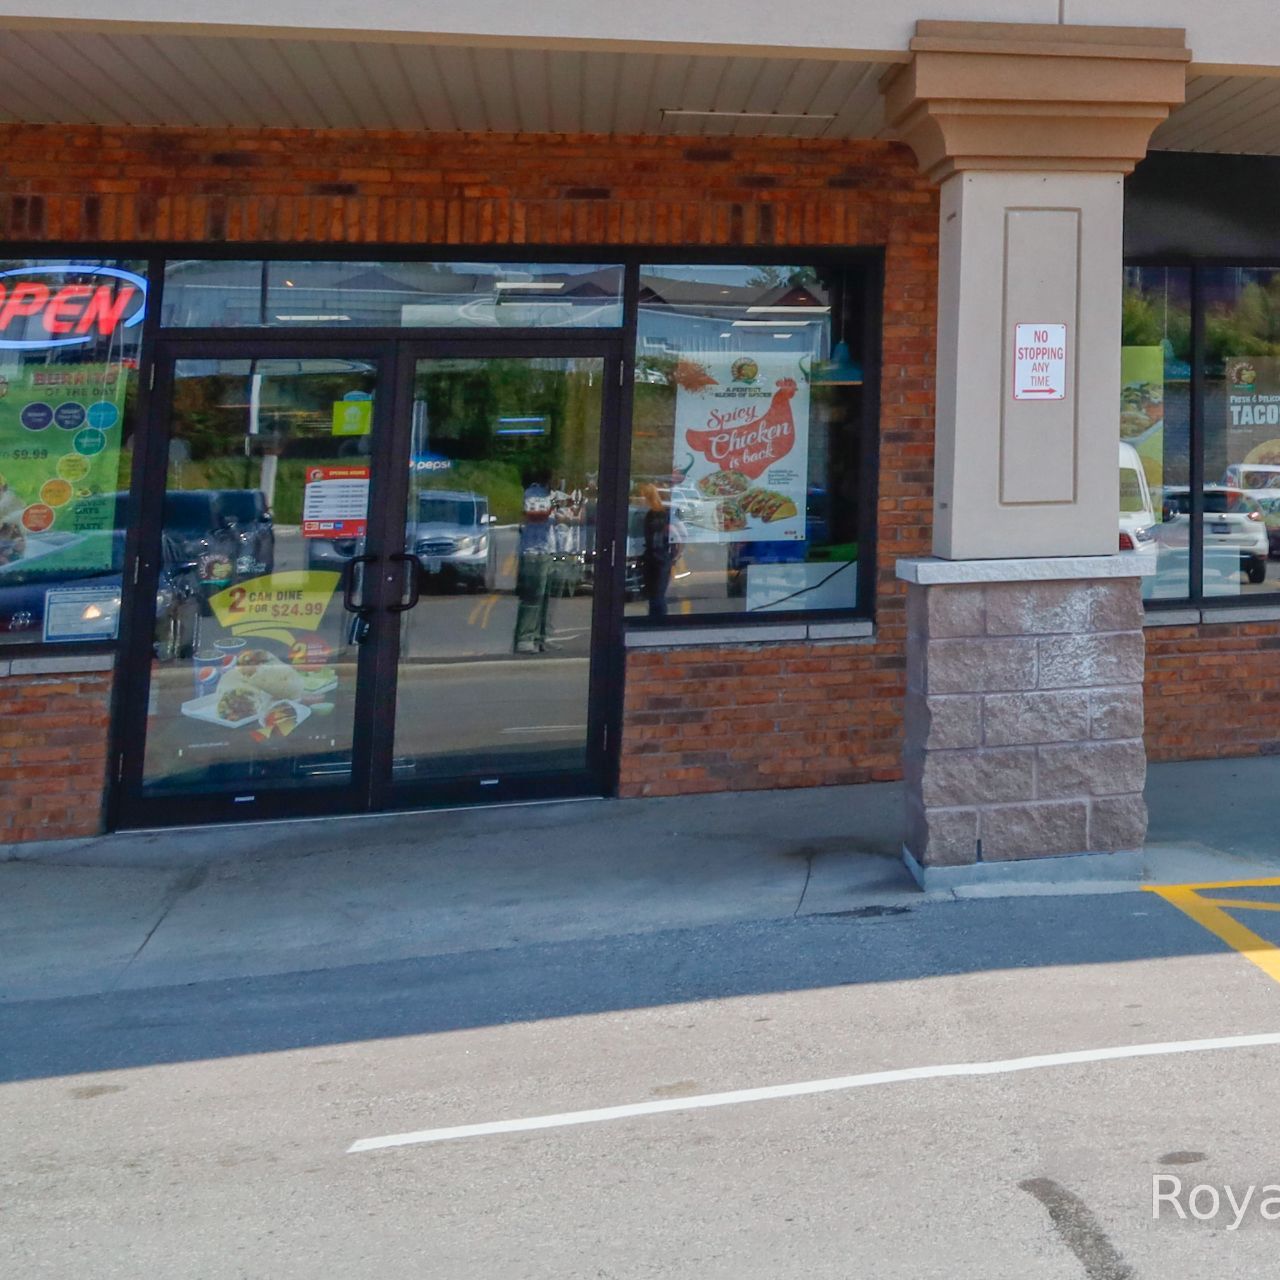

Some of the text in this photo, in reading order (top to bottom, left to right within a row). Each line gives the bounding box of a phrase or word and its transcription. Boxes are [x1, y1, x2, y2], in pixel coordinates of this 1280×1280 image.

[1034, 330, 1048, 343] NO
[1018, 347, 1063, 360] STOPPING
[1032, 362, 1050, 373] ANY
[1031, 376, 1050, 387] TIME
[707, 406, 758, 429] Spicy
[709, 420, 790, 459] Chicken
[729, 442, 775, 468] is back
[229, 587, 304, 613] 2 CAN DINE
[250, 602, 324, 618] FOR $24.99
